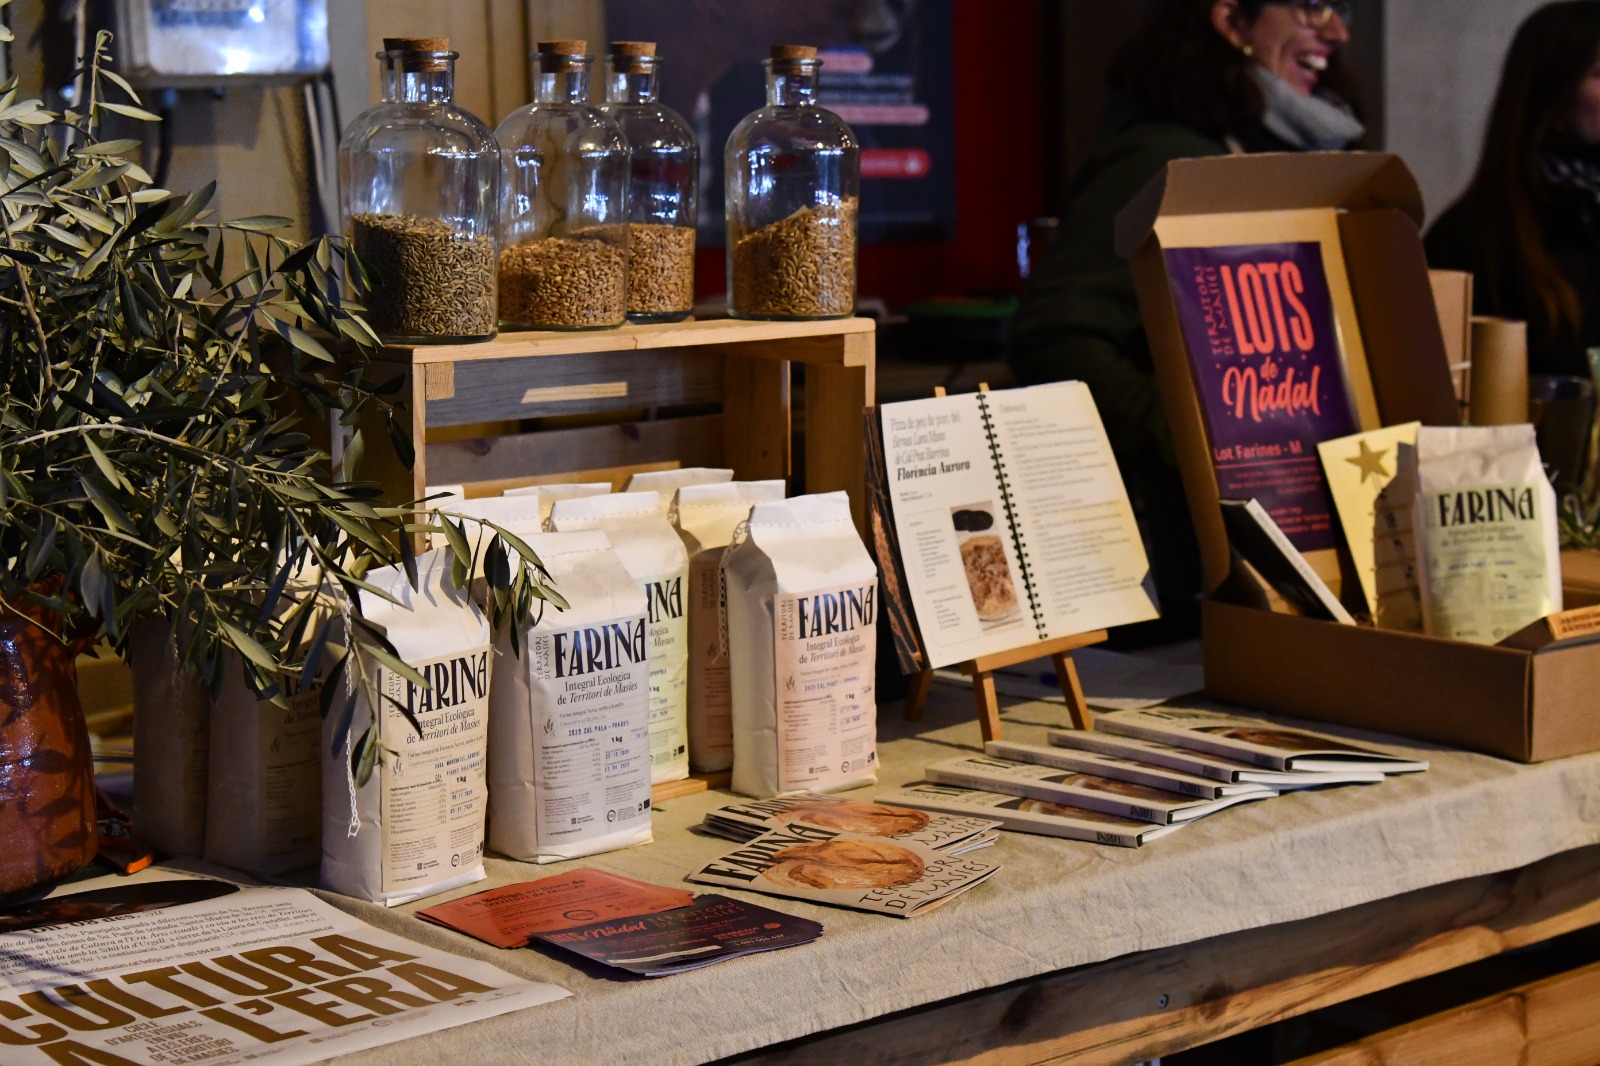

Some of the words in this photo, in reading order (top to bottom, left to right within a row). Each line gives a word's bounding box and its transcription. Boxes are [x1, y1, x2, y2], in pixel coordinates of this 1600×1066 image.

[1220, 262, 1315, 354] LOTS
[1260, 356, 1278, 382] de
[1222, 365, 1321, 422] Nadal
[1214, 447, 1232, 460] Lot
[1235, 444, 1281, 458] Farines
[897, 464, 936, 481] Florència
[940, 461, 970, 474] Aurora
[1438, 488, 1534, 527] FARINA
[797, 585, 874, 639] FARINA
[553, 618, 646, 678] FARINA
[799, 654, 808, 664] de
[810, 648, 838, 663] Territori
[840, 647, 847, 657] de
[807, 638, 832, 652] Integral
[406, 651, 487, 714] FARINA
[545, 671, 550, 680] DE
[565, 677, 596, 692] Integral
[598, 671, 630, 687] Ecològica
[557, 694, 566, 705] de
[570, 686, 602, 703] Territori
[604, 685, 611, 696] de
[614, 681, 638, 694] Masies
[418, 714, 444, 729] ntegral
[445, 708, 475, 723] Ecològica
[407, 733, 415, 744] de
[450, 724, 458, 734] de
[460, 719, 481, 732] Masies
[912, 818, 991, 845] MASIES
[885, 893, 920, 909] DE
[912, 860, 989, 895] MASIES
[80, 926, 120, 936] Passejada
[122, 922, 150, 931] guiada
[156, 915, 193, 925] diferents
[103, 914, 140, 922] des.
[584, 921, 648, 938] Nadal
[81, 941, 116, 949] Cultura
[98, 944, 130, 953] Sibil·la
[0, 934, 420, 1046] CULTURA
[198, 962, 500, 1043] L'ERA
[104, 1032, 152, 1045] D'ARTS
[148, 1020, 203, 1035] VISUALS
[123, 1021, 162, 1033] CICLE
[144, 1036, 166, 1044] EN
[166, 1031, 189, 1040] VIU
[149, 1053, 171, 1062] DE
[166, 1038, 234, 1057] TERRITORI
[155, 1041, 182, 1051] LES
[178, 1034, 213, 1045] ERES
[186, 1047, 240, 1061] MASIES
